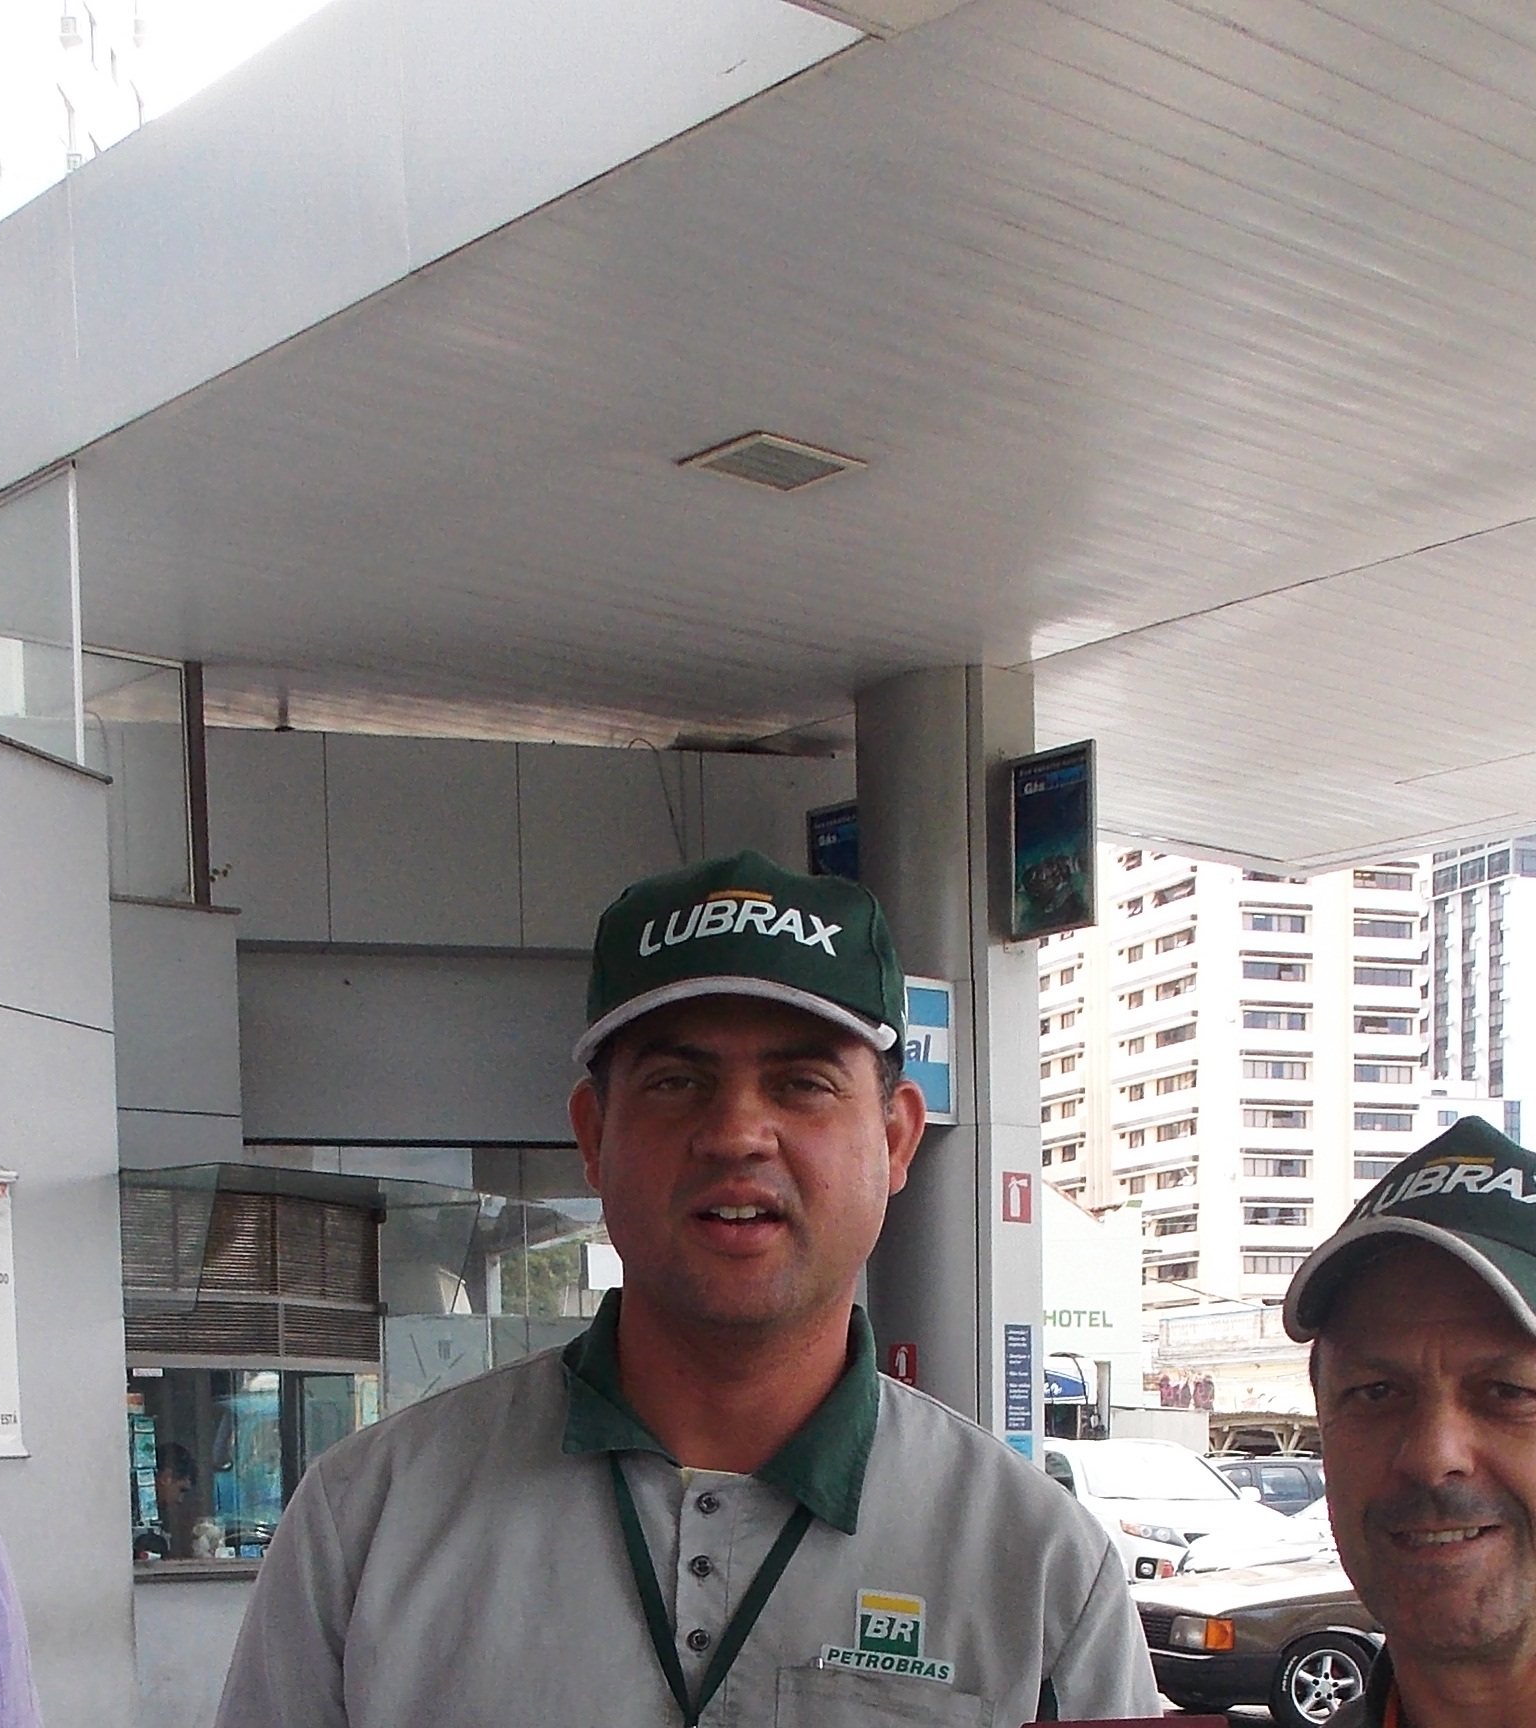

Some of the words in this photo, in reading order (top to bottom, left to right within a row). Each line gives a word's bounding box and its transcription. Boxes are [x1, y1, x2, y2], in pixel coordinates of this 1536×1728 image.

[638, 898, 843, 957] LUBRAX
[1043, 1309, 1114, 1329] HOTEL
[0, 1410, 18, 1426] ESTÁ
[865, 1615, 915, 1643] BR
[827, 1648, 951, 1681] PETROBRAS
